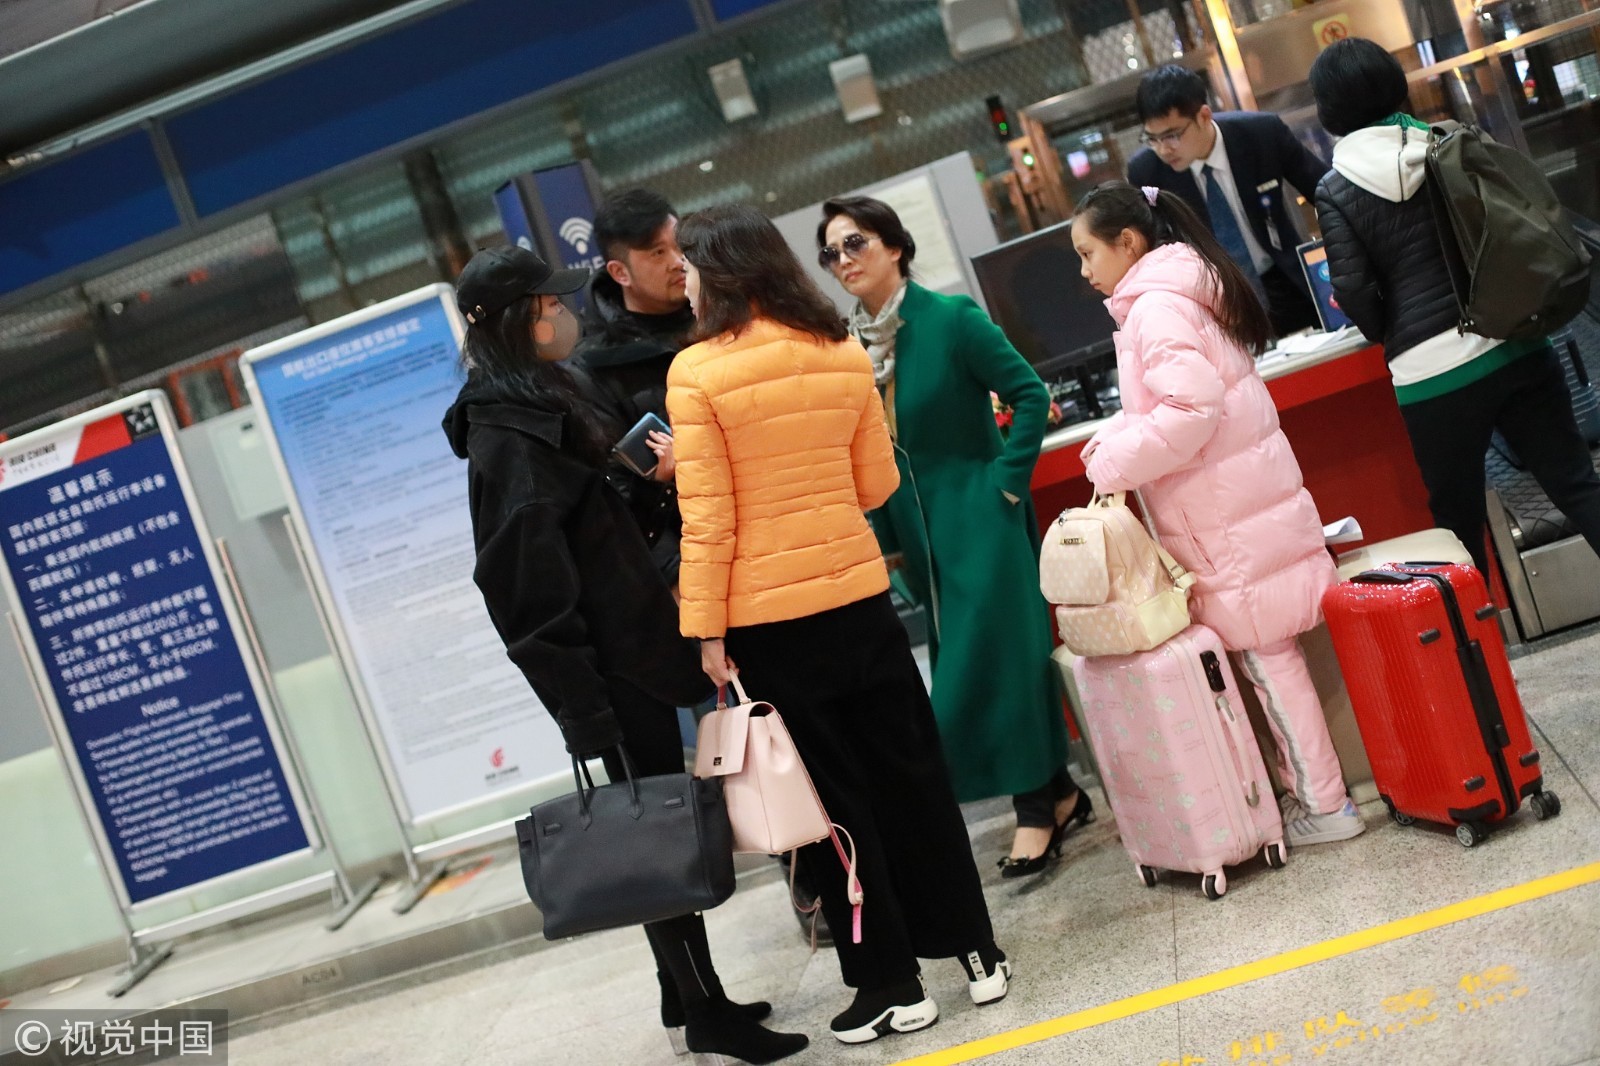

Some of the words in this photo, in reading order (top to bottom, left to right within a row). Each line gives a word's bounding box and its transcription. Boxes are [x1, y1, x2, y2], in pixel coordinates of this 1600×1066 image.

[48, 468, 112, 503] 温馨提示
[140, 696, 179, 716] Notice
